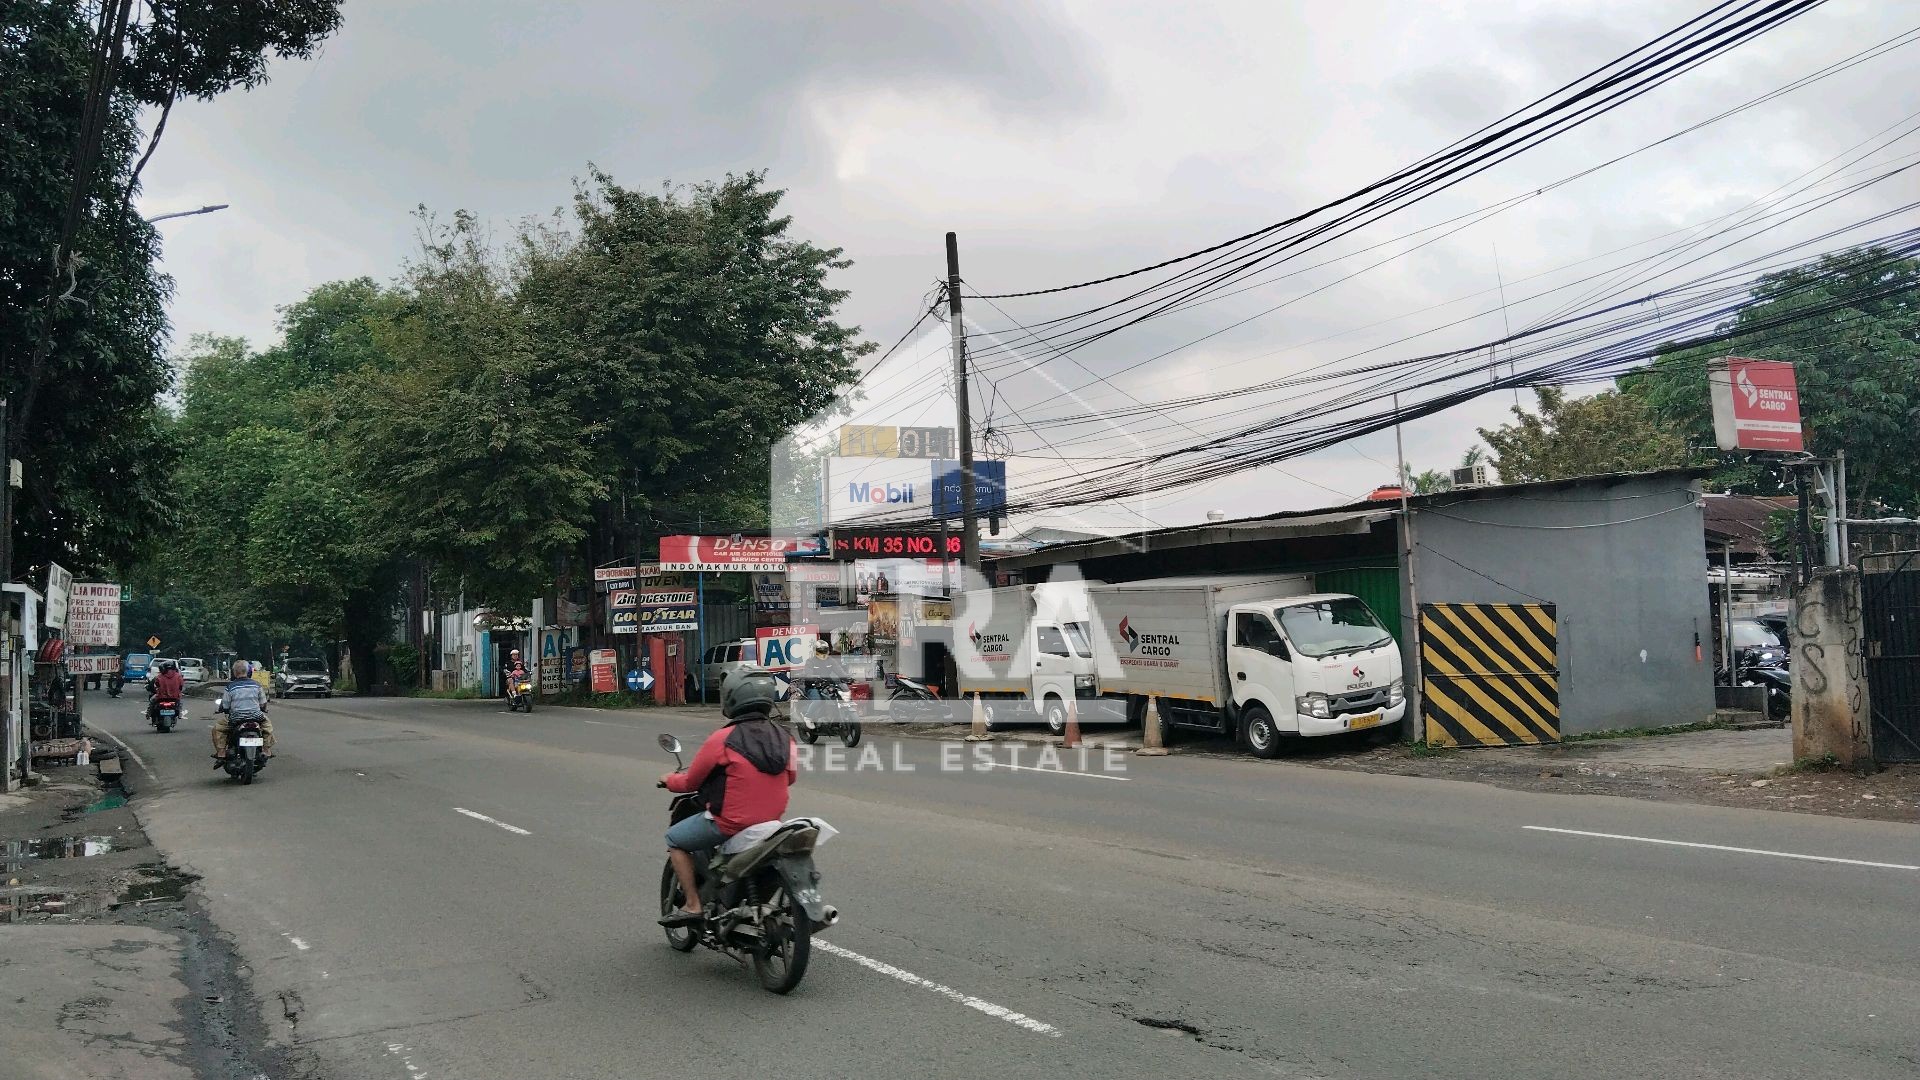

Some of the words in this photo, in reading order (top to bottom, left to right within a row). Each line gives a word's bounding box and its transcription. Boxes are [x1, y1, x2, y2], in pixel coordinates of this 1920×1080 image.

[1759, 389, 1793, 401] SENTRAL
[1760, 400, 1786, 411] CARGO
[849, 482, 913, 503] Mobil
[714, 538, 787, 551] DENSO
[854, 537, 879, 553] KM
[884, 537, 903, 553] 35
[907, 537, 937, 553] NO.
[616, 593, 694, 605] BRIDGESTONE
[772, 626, 806, 636] DENSO
[544, 631, 571, 658] AC
[983, 634, 1009, 643] SENTRAL
[1141, 635, 1179, 645] SENTRAL
[764, 637, 804, 667] AC
[983, 644, 1003, 652] CARGO
[1141, 646, 1171, 656] CARGO
[68, 659, 92, 672] PRESS
[96, 657, 119, 671] MOTOR
[1347, 681, 1373, 690] ISUZU
